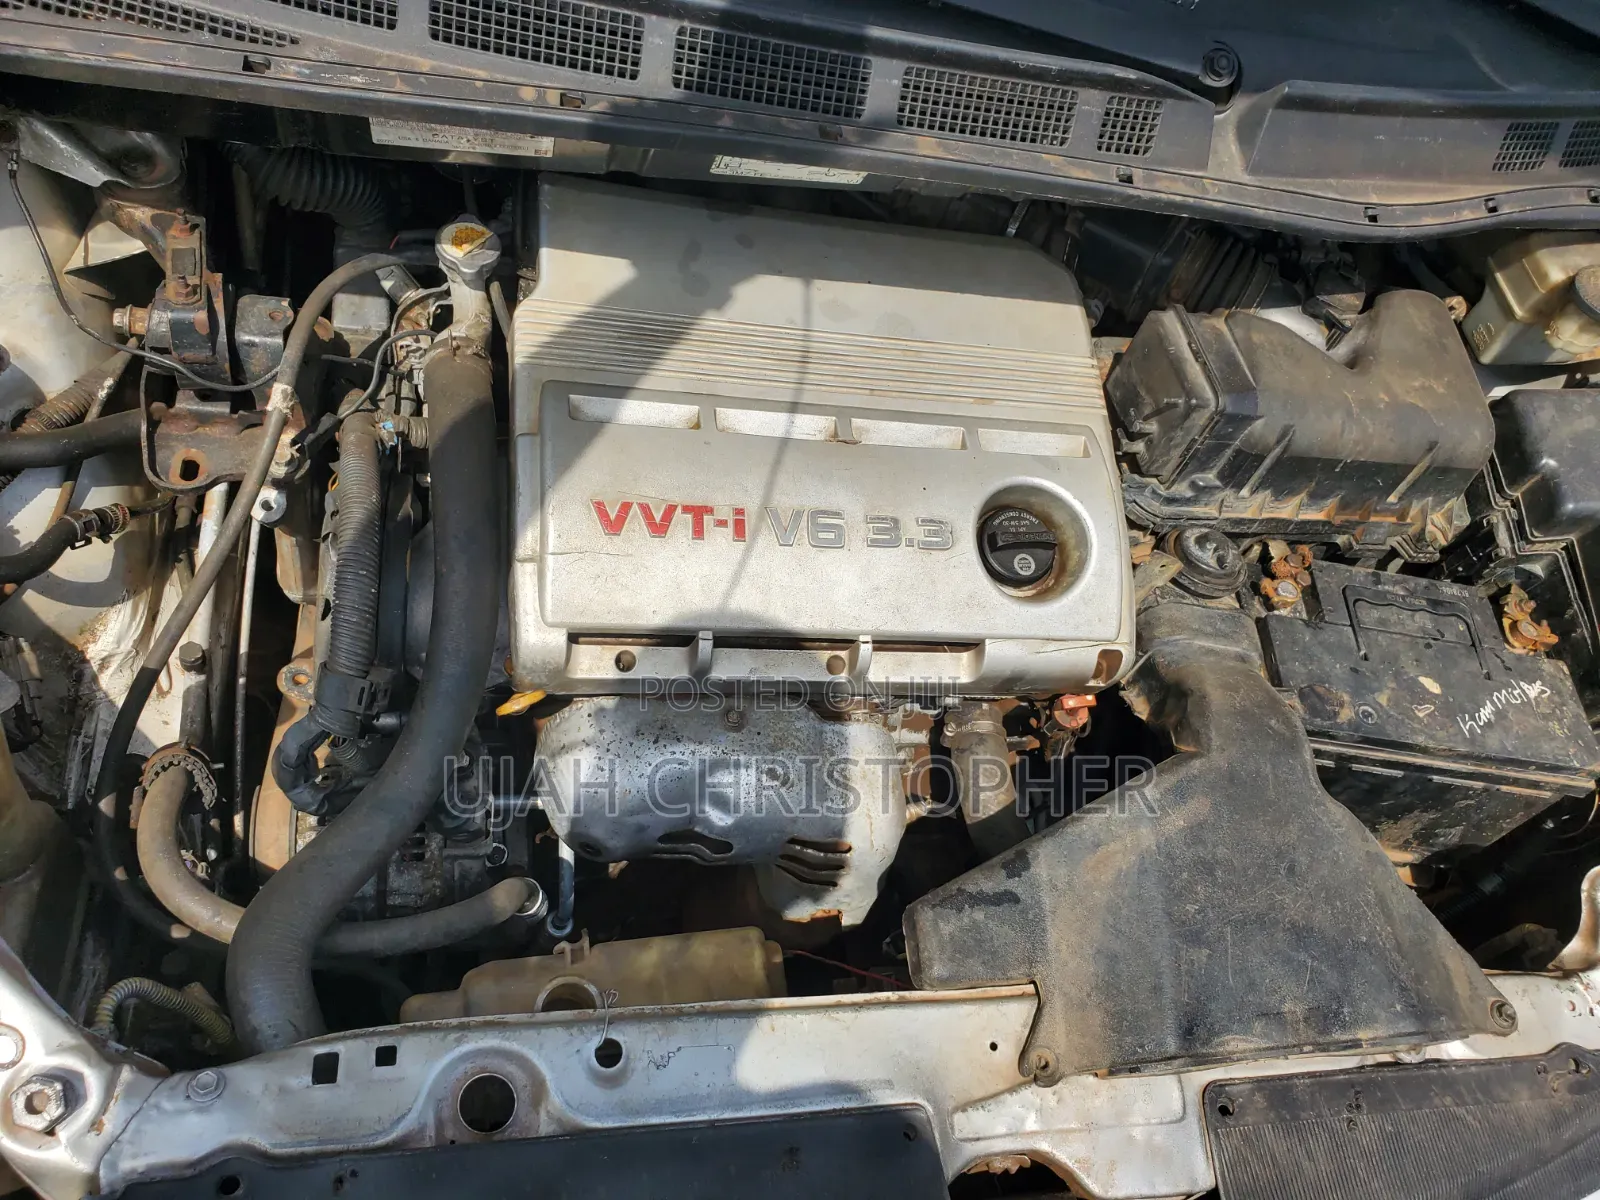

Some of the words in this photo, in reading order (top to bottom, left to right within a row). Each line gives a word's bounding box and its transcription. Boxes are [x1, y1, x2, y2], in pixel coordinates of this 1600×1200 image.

[590, 498, 748, 542] VVT-i
[764, 506, 846, 549] V6
[865, 513, 953, 550] 3.3
